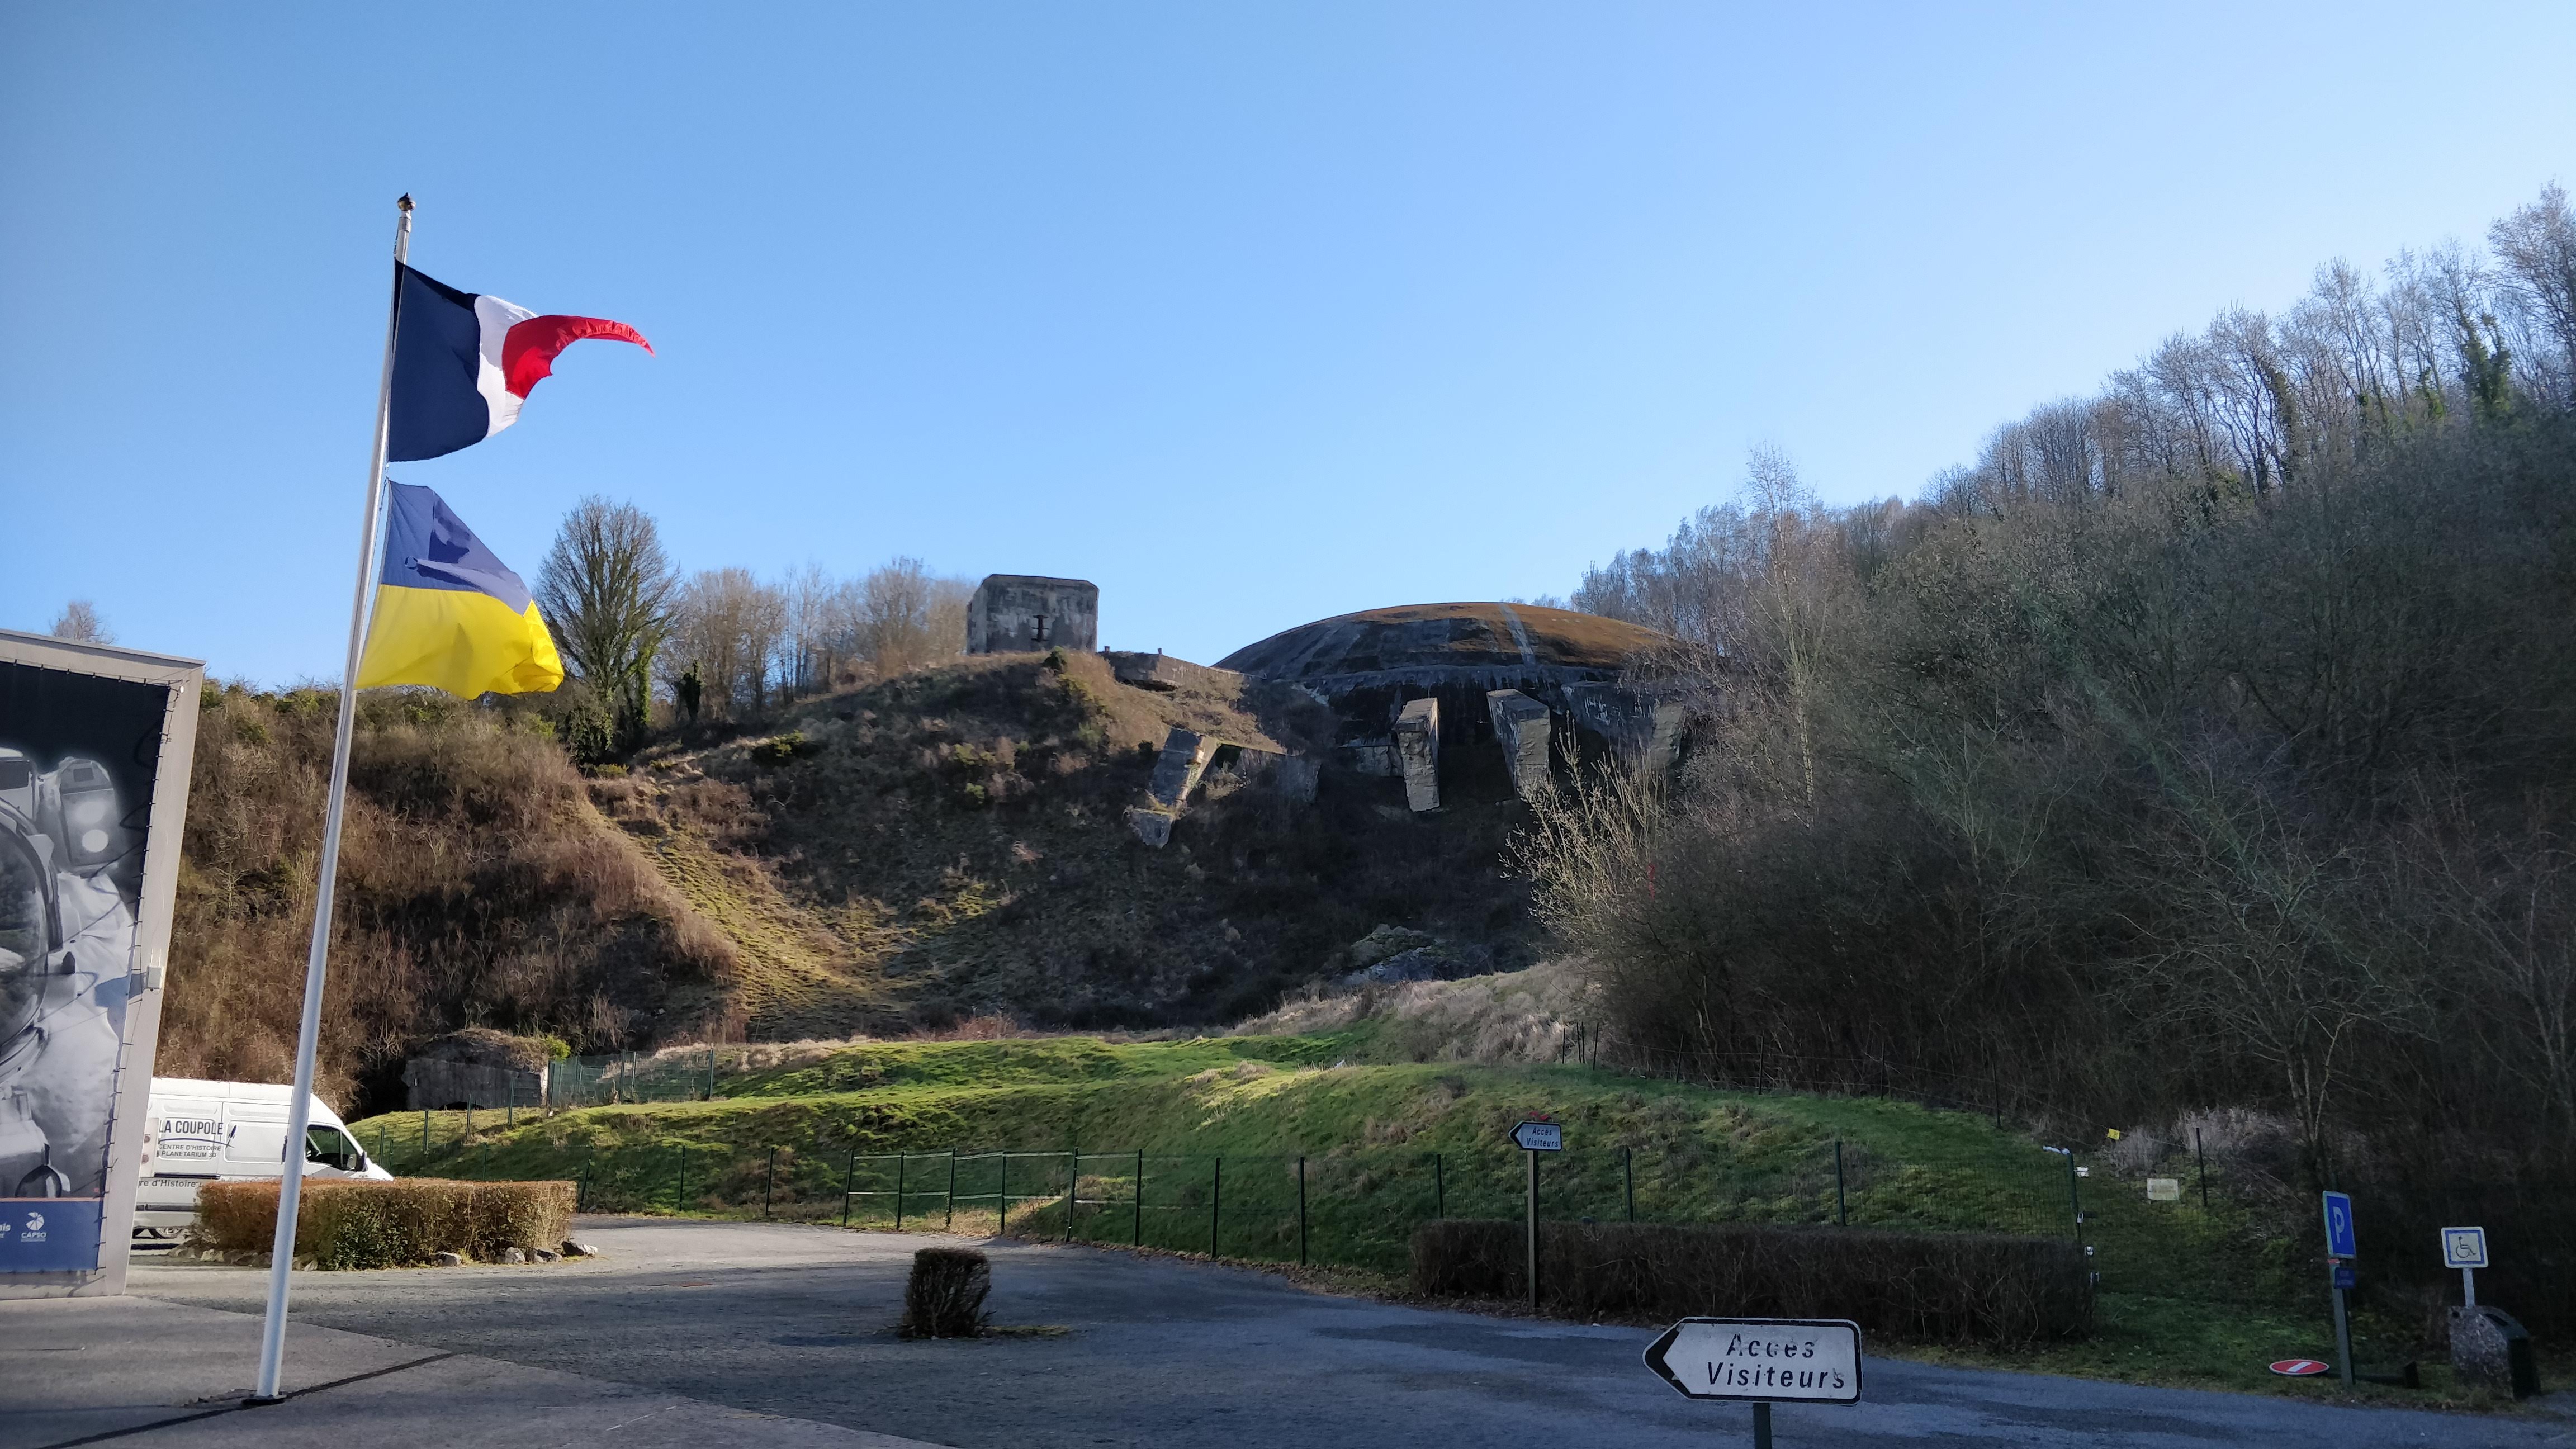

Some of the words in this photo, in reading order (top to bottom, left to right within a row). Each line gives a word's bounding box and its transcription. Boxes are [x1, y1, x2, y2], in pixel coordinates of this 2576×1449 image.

[159, 1120, 172, 1133] LA
[175, 1121, 224, 1135] COUPOLE
[1532, 1126, 1552, 1135] Accès
[1526, 1138, 1559, 1147] Visiteurs
[2333, 1206, 2345, 1244] P
[1707, 1361, 1845, 1389] Visiteurs
